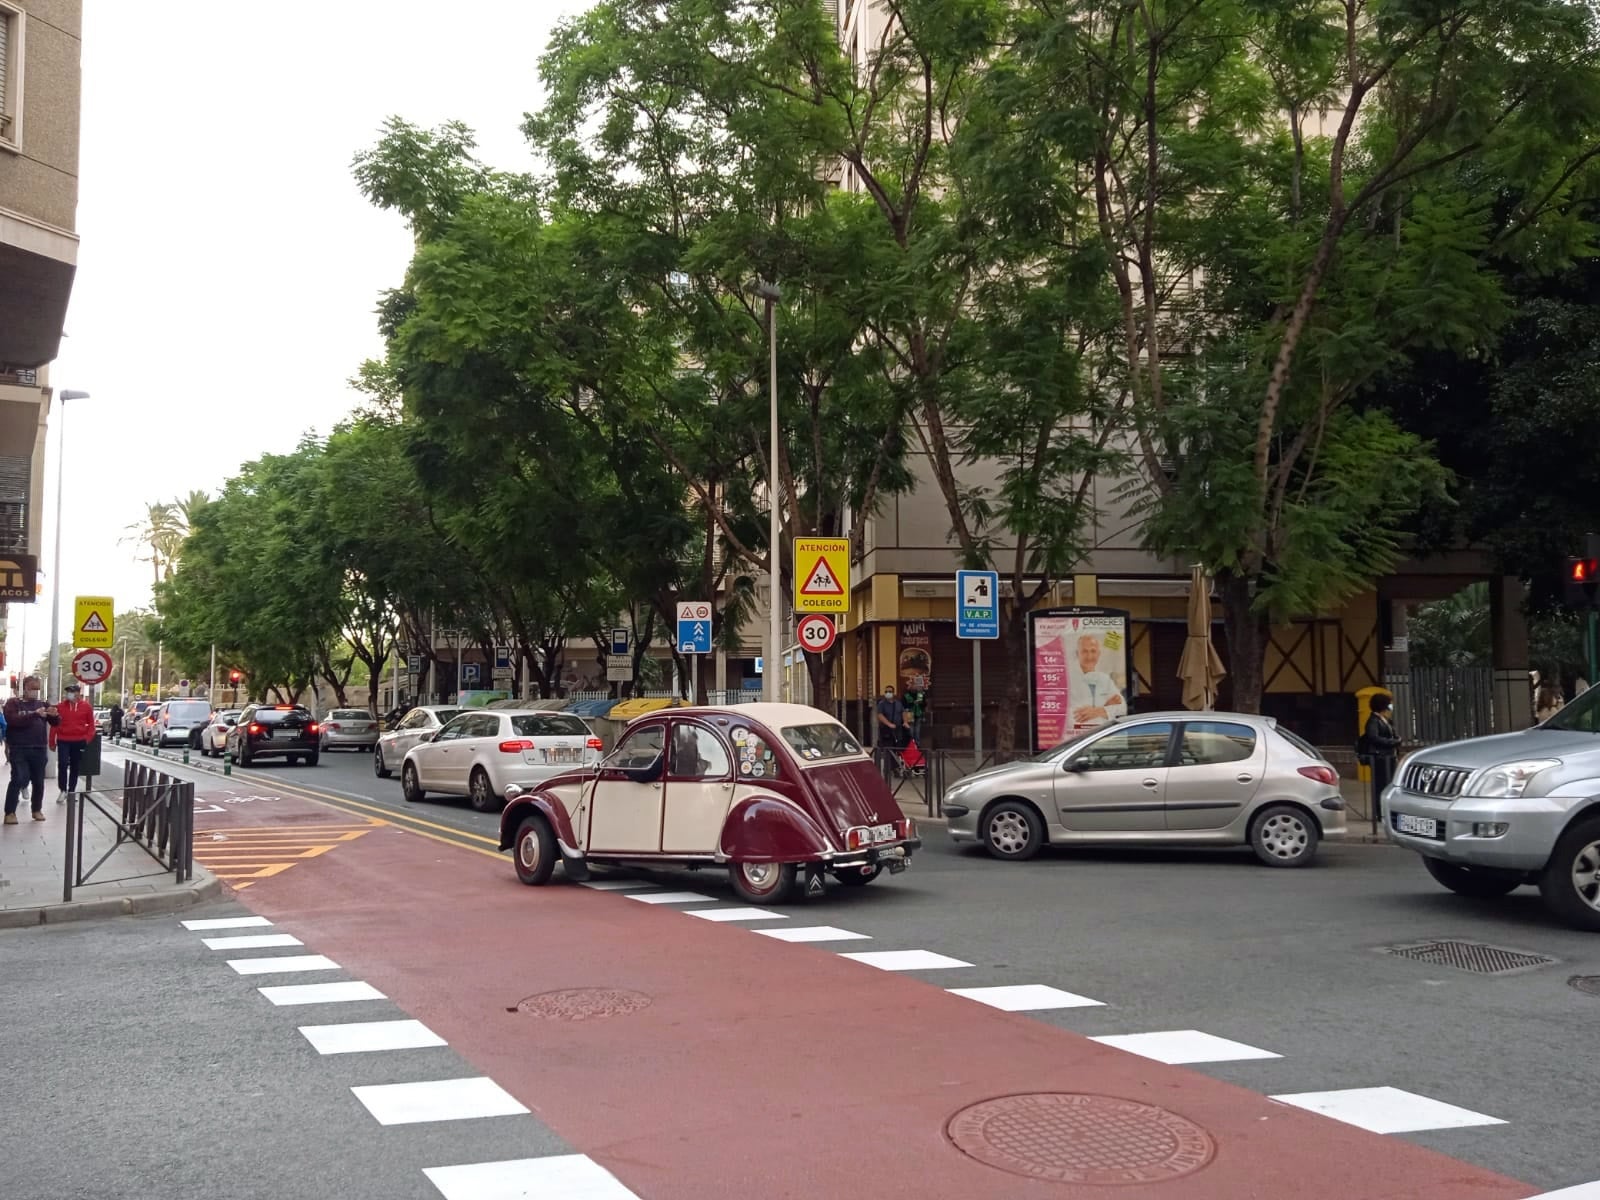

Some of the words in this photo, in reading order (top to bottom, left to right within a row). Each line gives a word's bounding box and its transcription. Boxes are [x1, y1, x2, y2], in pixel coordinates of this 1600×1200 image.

[802, 599, 842, 607] COLEGIO
[966, 610, 991, 618] V.A.P.
[805, 626, 828, 640] 30
